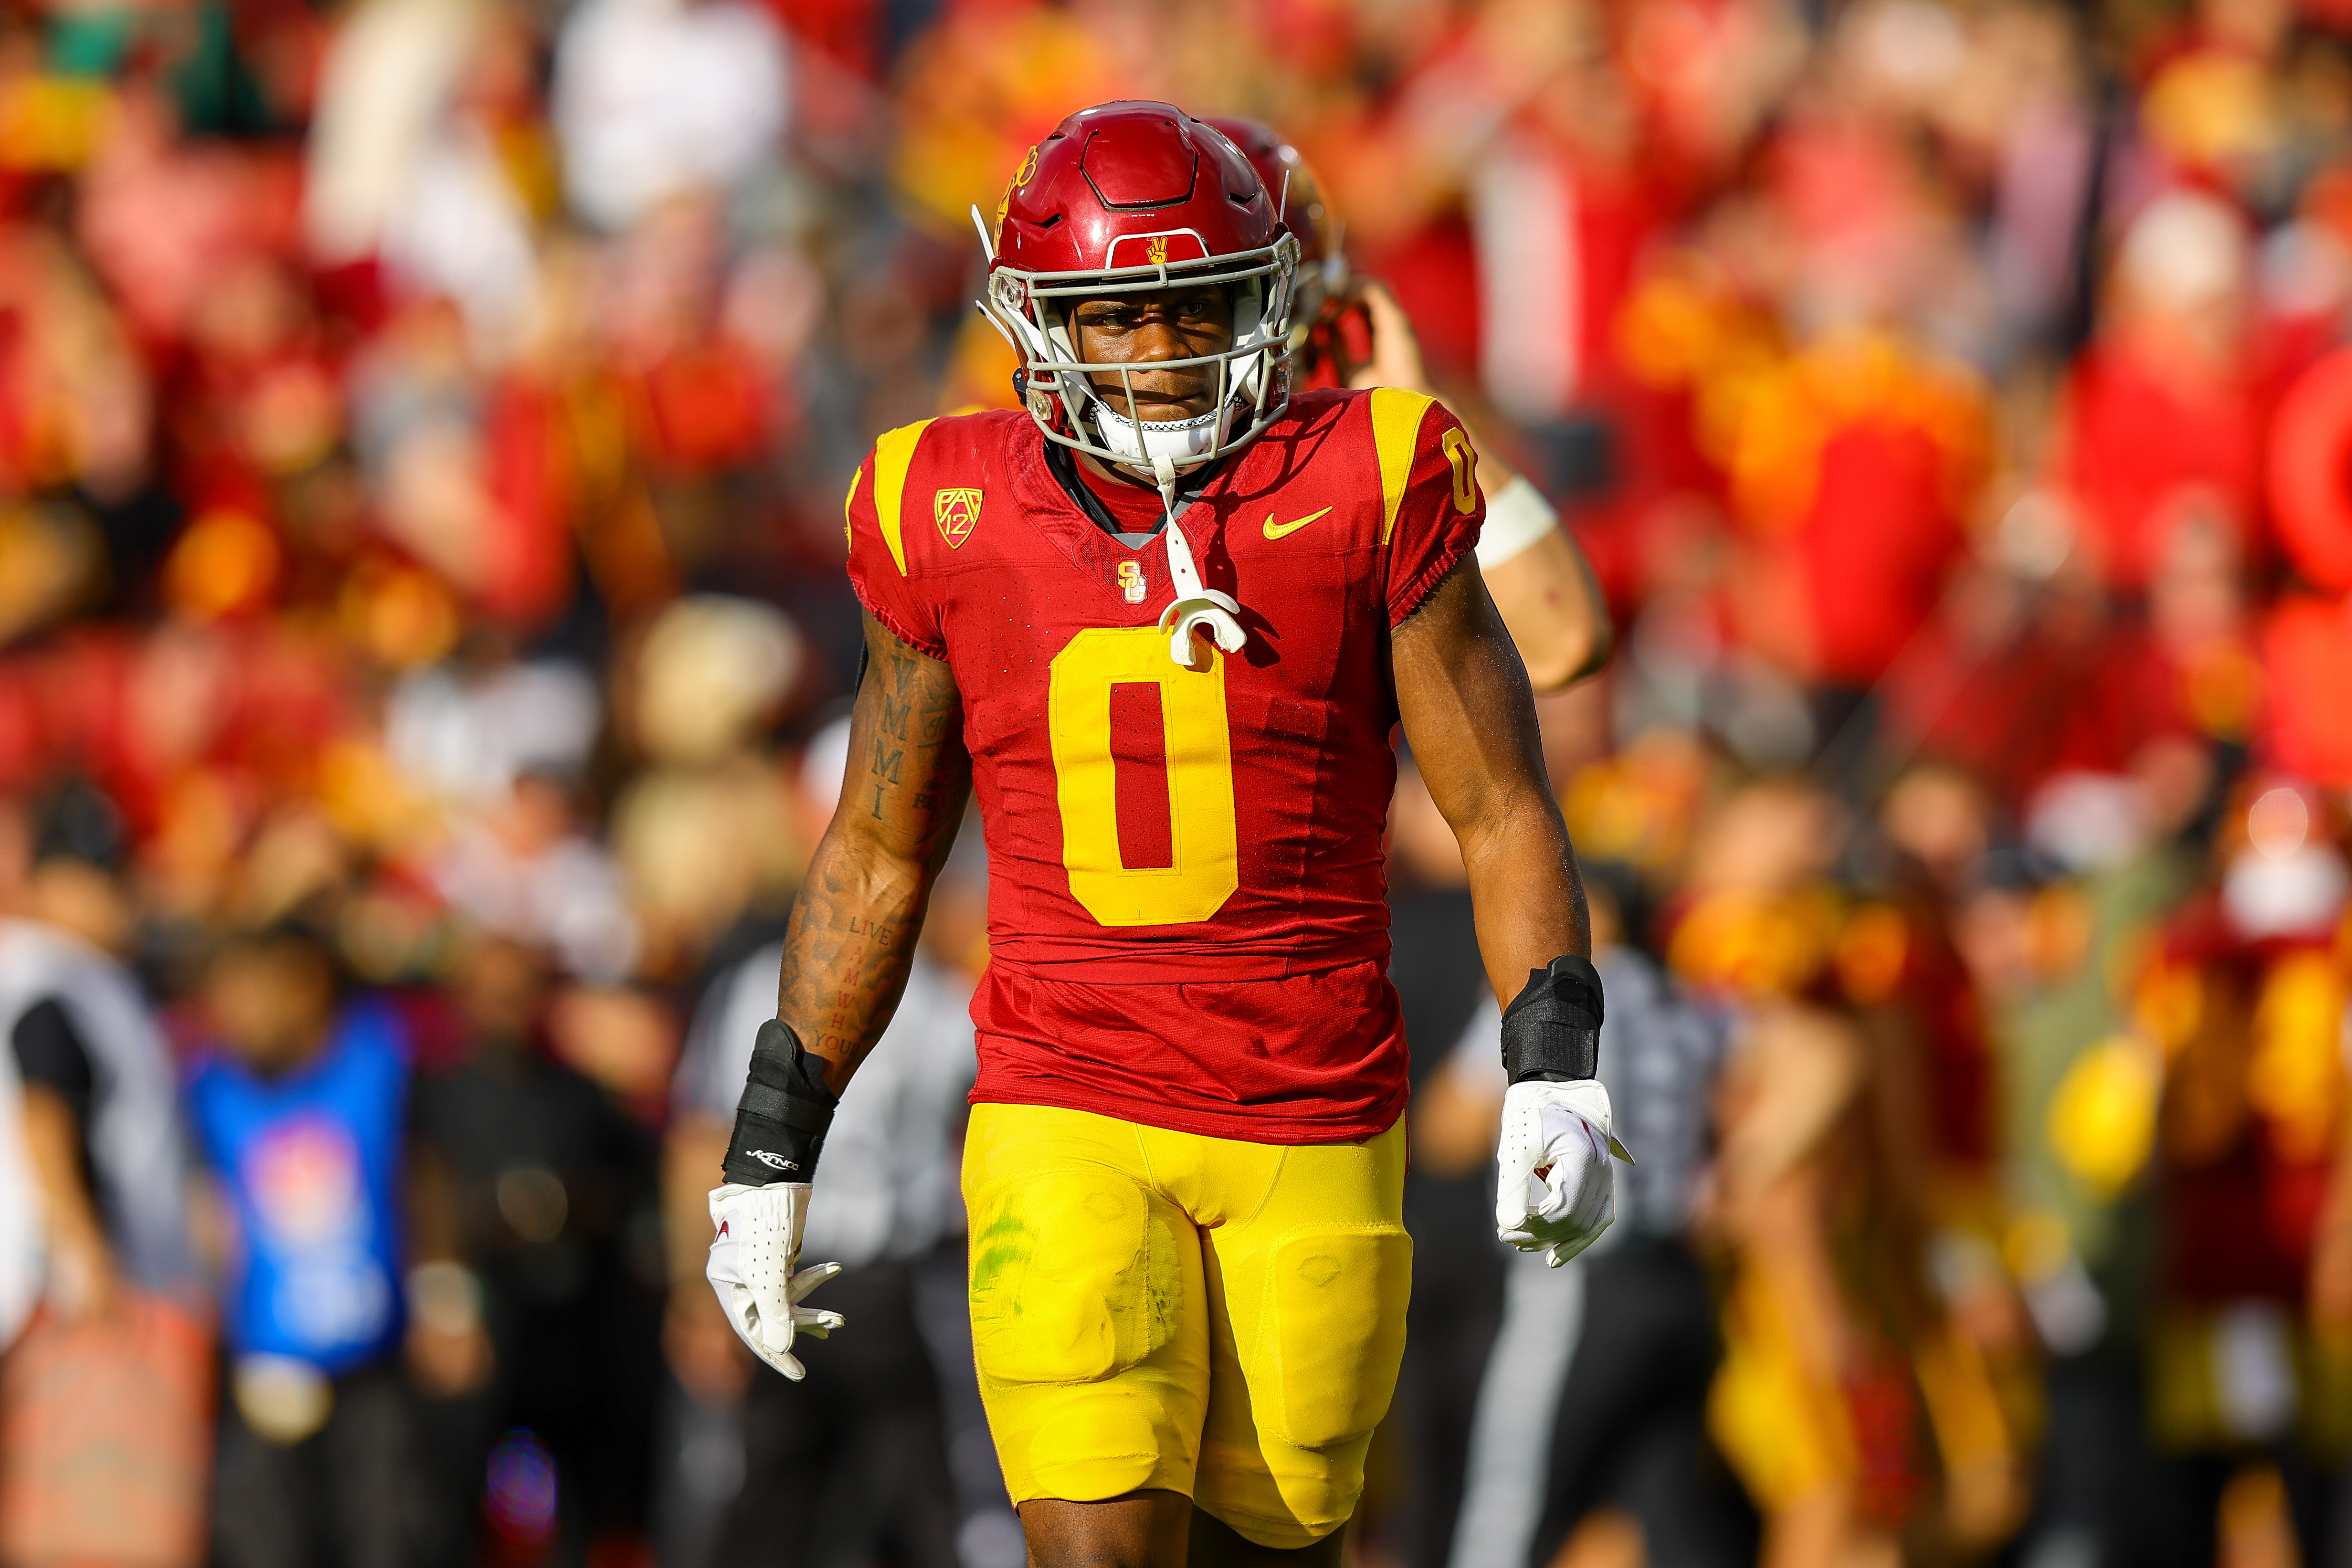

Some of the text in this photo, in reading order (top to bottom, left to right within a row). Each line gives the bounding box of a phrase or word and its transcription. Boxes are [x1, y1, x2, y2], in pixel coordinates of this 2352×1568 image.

[1442, 426, 1476, 516] 0
[937, 490, 980, 524] PAC
[946, 513, 968, 535] 12
[1118, 561, 1146, 601] SC
[1049, 626, 1239, 927] 0
[849, 916, 892, 946] LIVE
[814, 1029, 861, 1058] YOUR
